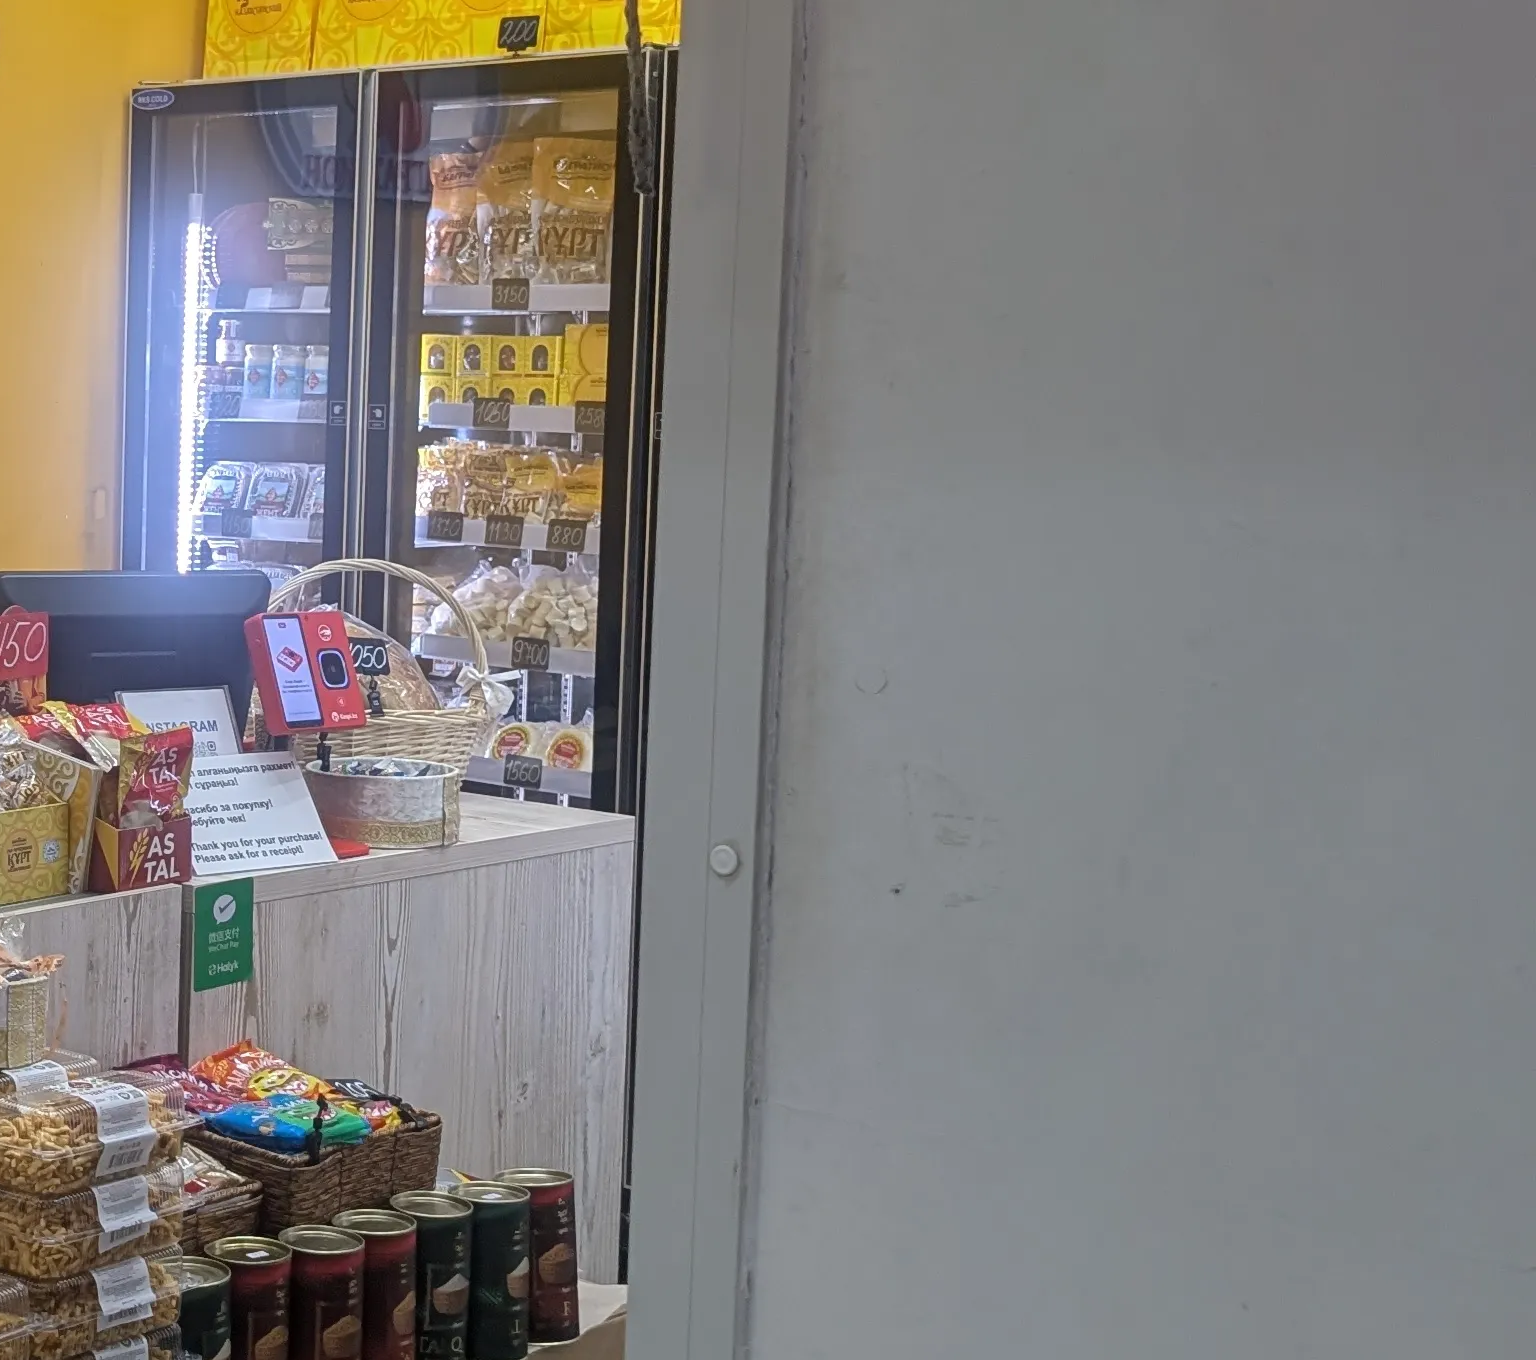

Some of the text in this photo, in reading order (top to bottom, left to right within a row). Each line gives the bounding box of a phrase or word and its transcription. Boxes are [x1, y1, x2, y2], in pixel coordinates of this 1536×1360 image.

[500, 20, 539, 45] 200
[494, 281, 528, 305] 3150
[551, 525, 583, 546] 880
[348, 643, 387, 669] 050
[153, 747, 178, 766] AS
[504, 759, 541, 785] 1560
[184, 803, 218, 815] пасибо
[220, 804, 231, 813] за
[193, 816, 225, 828] ебуйте
[148, 832, 175, 859] AS
[192, 831, 323, 852] Thank you for your purchase!
[194, 852, 226, 864] Please
[228, 850, 245, 860] ask
[246, 848, 260, 858] for
[270, 845, 304, 858] receipt!
[144, 854, 181, 884] TAL
[217, 959, 239, 973] Halyk
